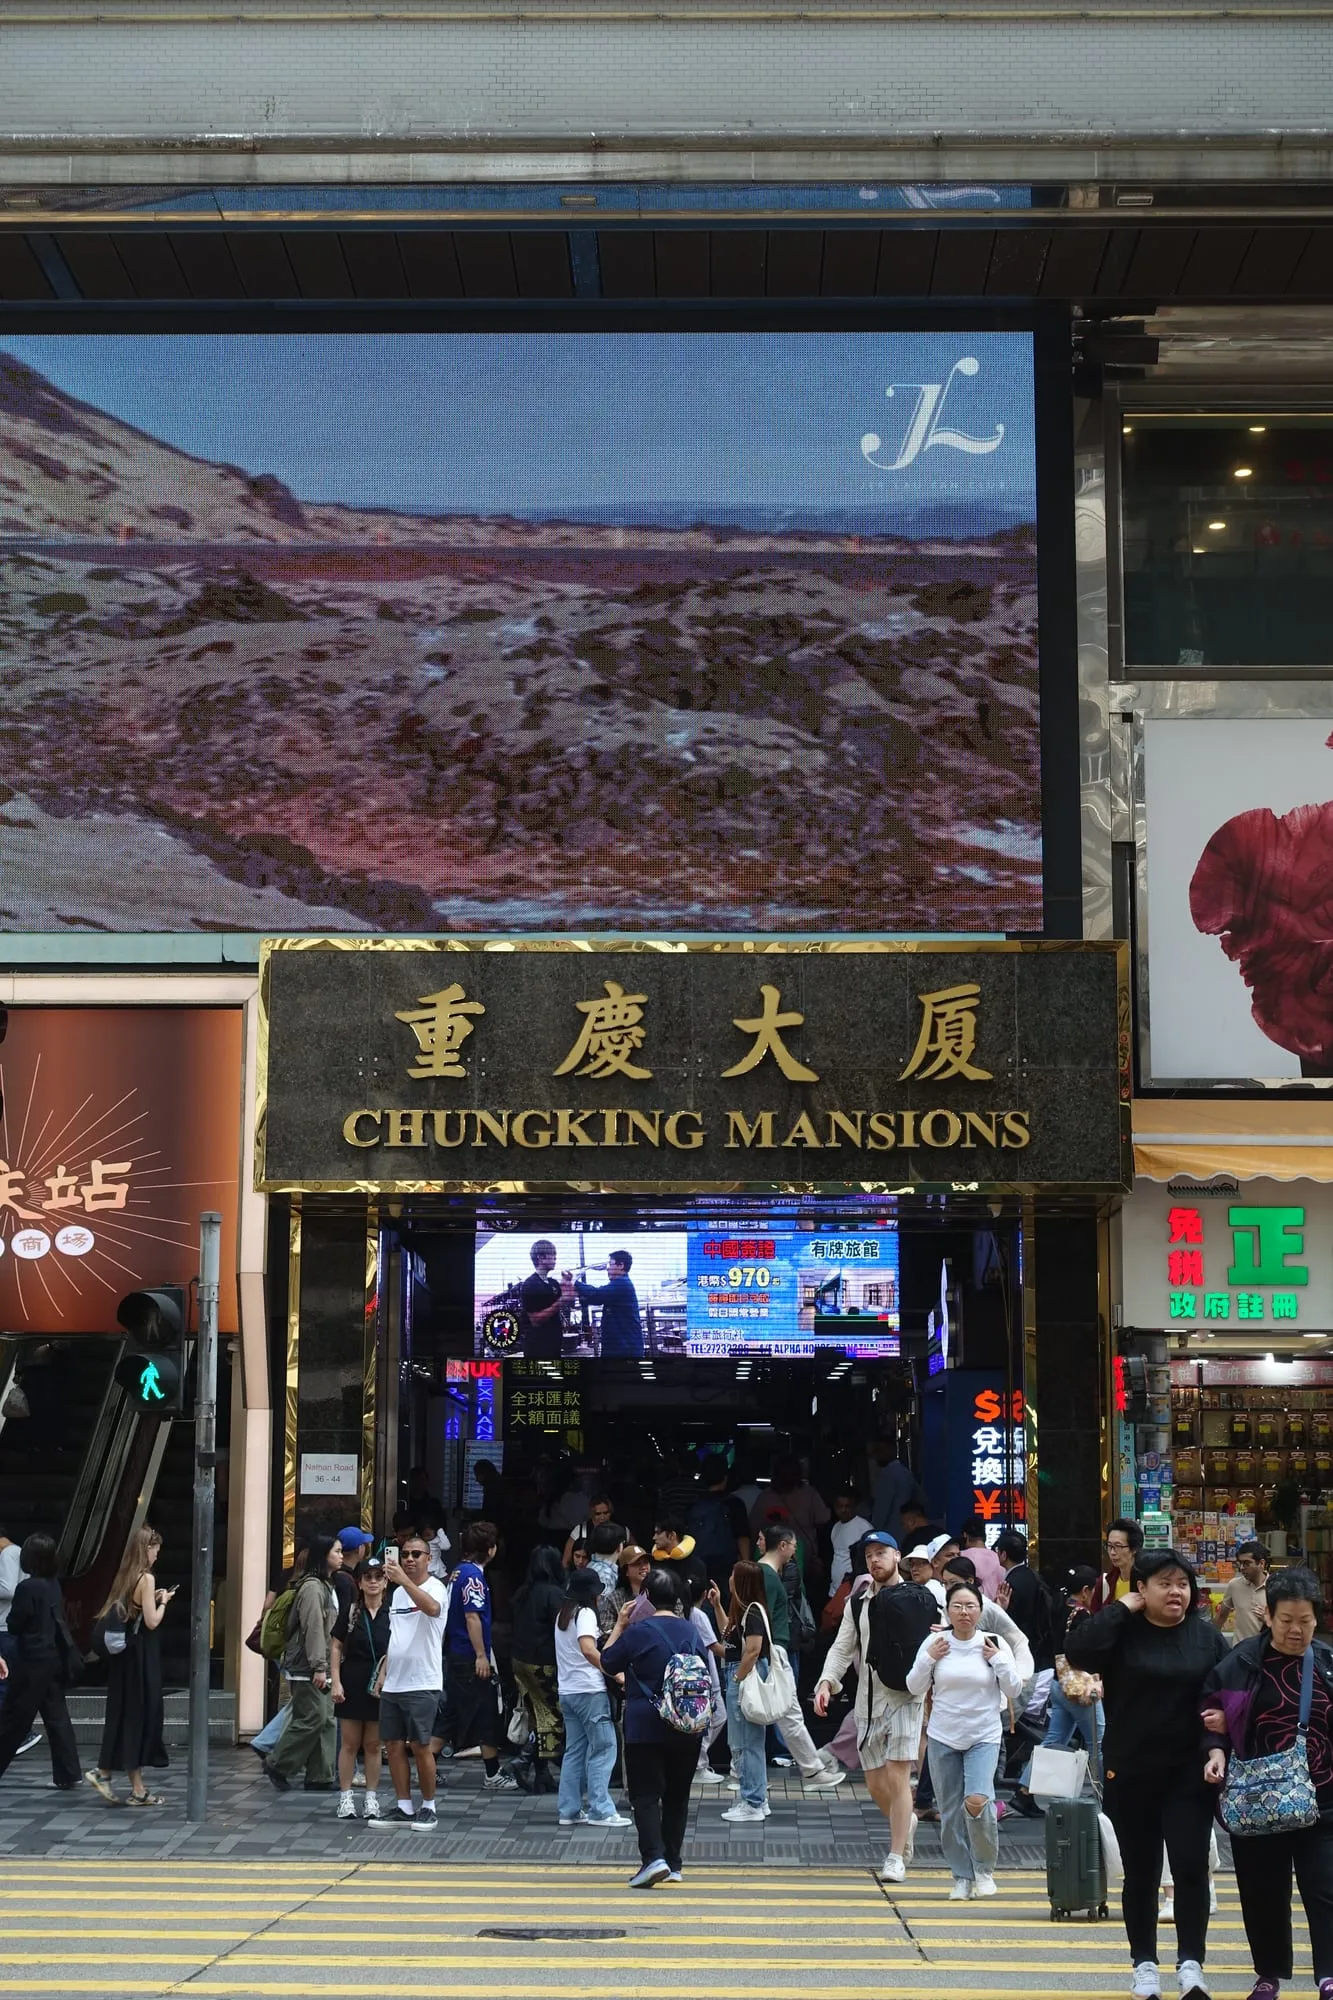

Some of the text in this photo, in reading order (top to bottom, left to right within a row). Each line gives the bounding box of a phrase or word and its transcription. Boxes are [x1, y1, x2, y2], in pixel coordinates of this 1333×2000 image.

[343, 1109, 1032, 1151] CHUNGKING MANSIONS
[704, 1239, 775, 1260] 中國簽證
[811, 1240, 879, 1259] 有牌旅館
[1228, 1207, 1308, 1285] 正
[1170, 1292, 1297, 1319] 政府註冊
[775, 1344, 801, 1354] ALPHA
[510, 1391, 581, 1406] 全球匯款
[510, 1410, 581, 1425] 大額面議
